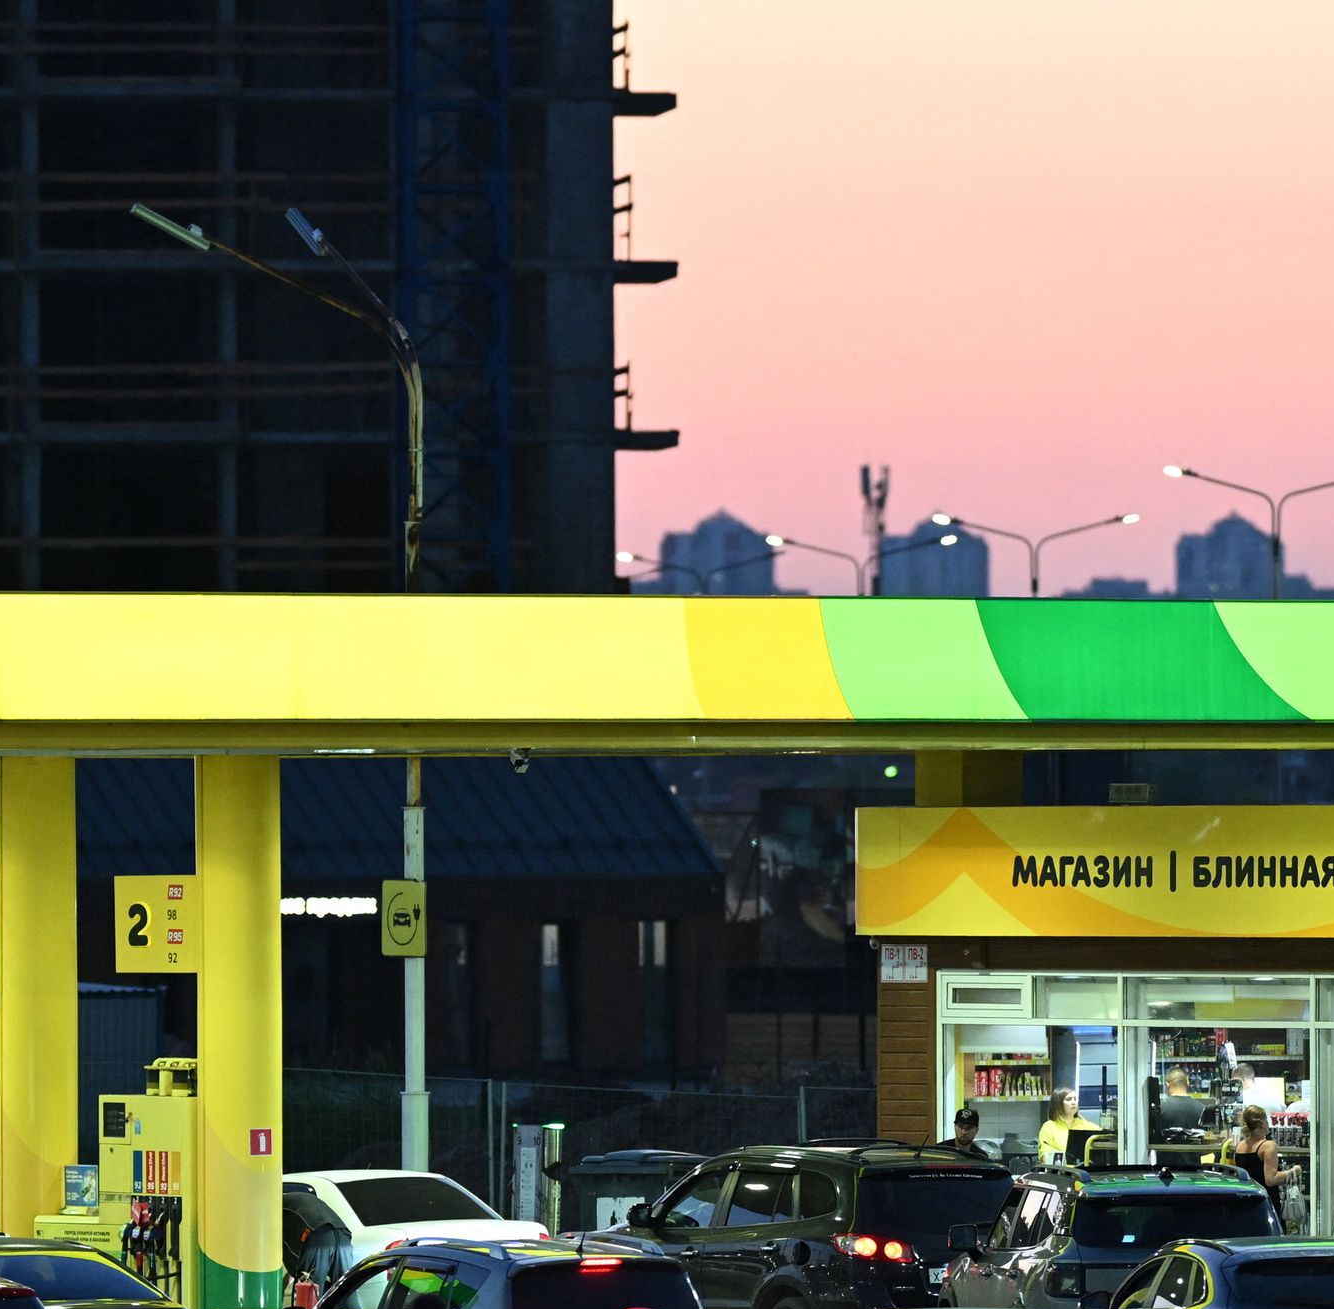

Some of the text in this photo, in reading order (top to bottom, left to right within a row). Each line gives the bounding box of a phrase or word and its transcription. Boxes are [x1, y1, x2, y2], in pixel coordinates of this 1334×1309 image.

[1012, 855, 1153, 888] МАГАЗИН
[168, 887, 183, 898] R92
[167, 909, 177, 920] 98
[128, 903, 149, 947] 2
[168, 931, 183, 942] R95
[168, 952, 178, 963] 92
[134, 1181, 142, 1190] 92
